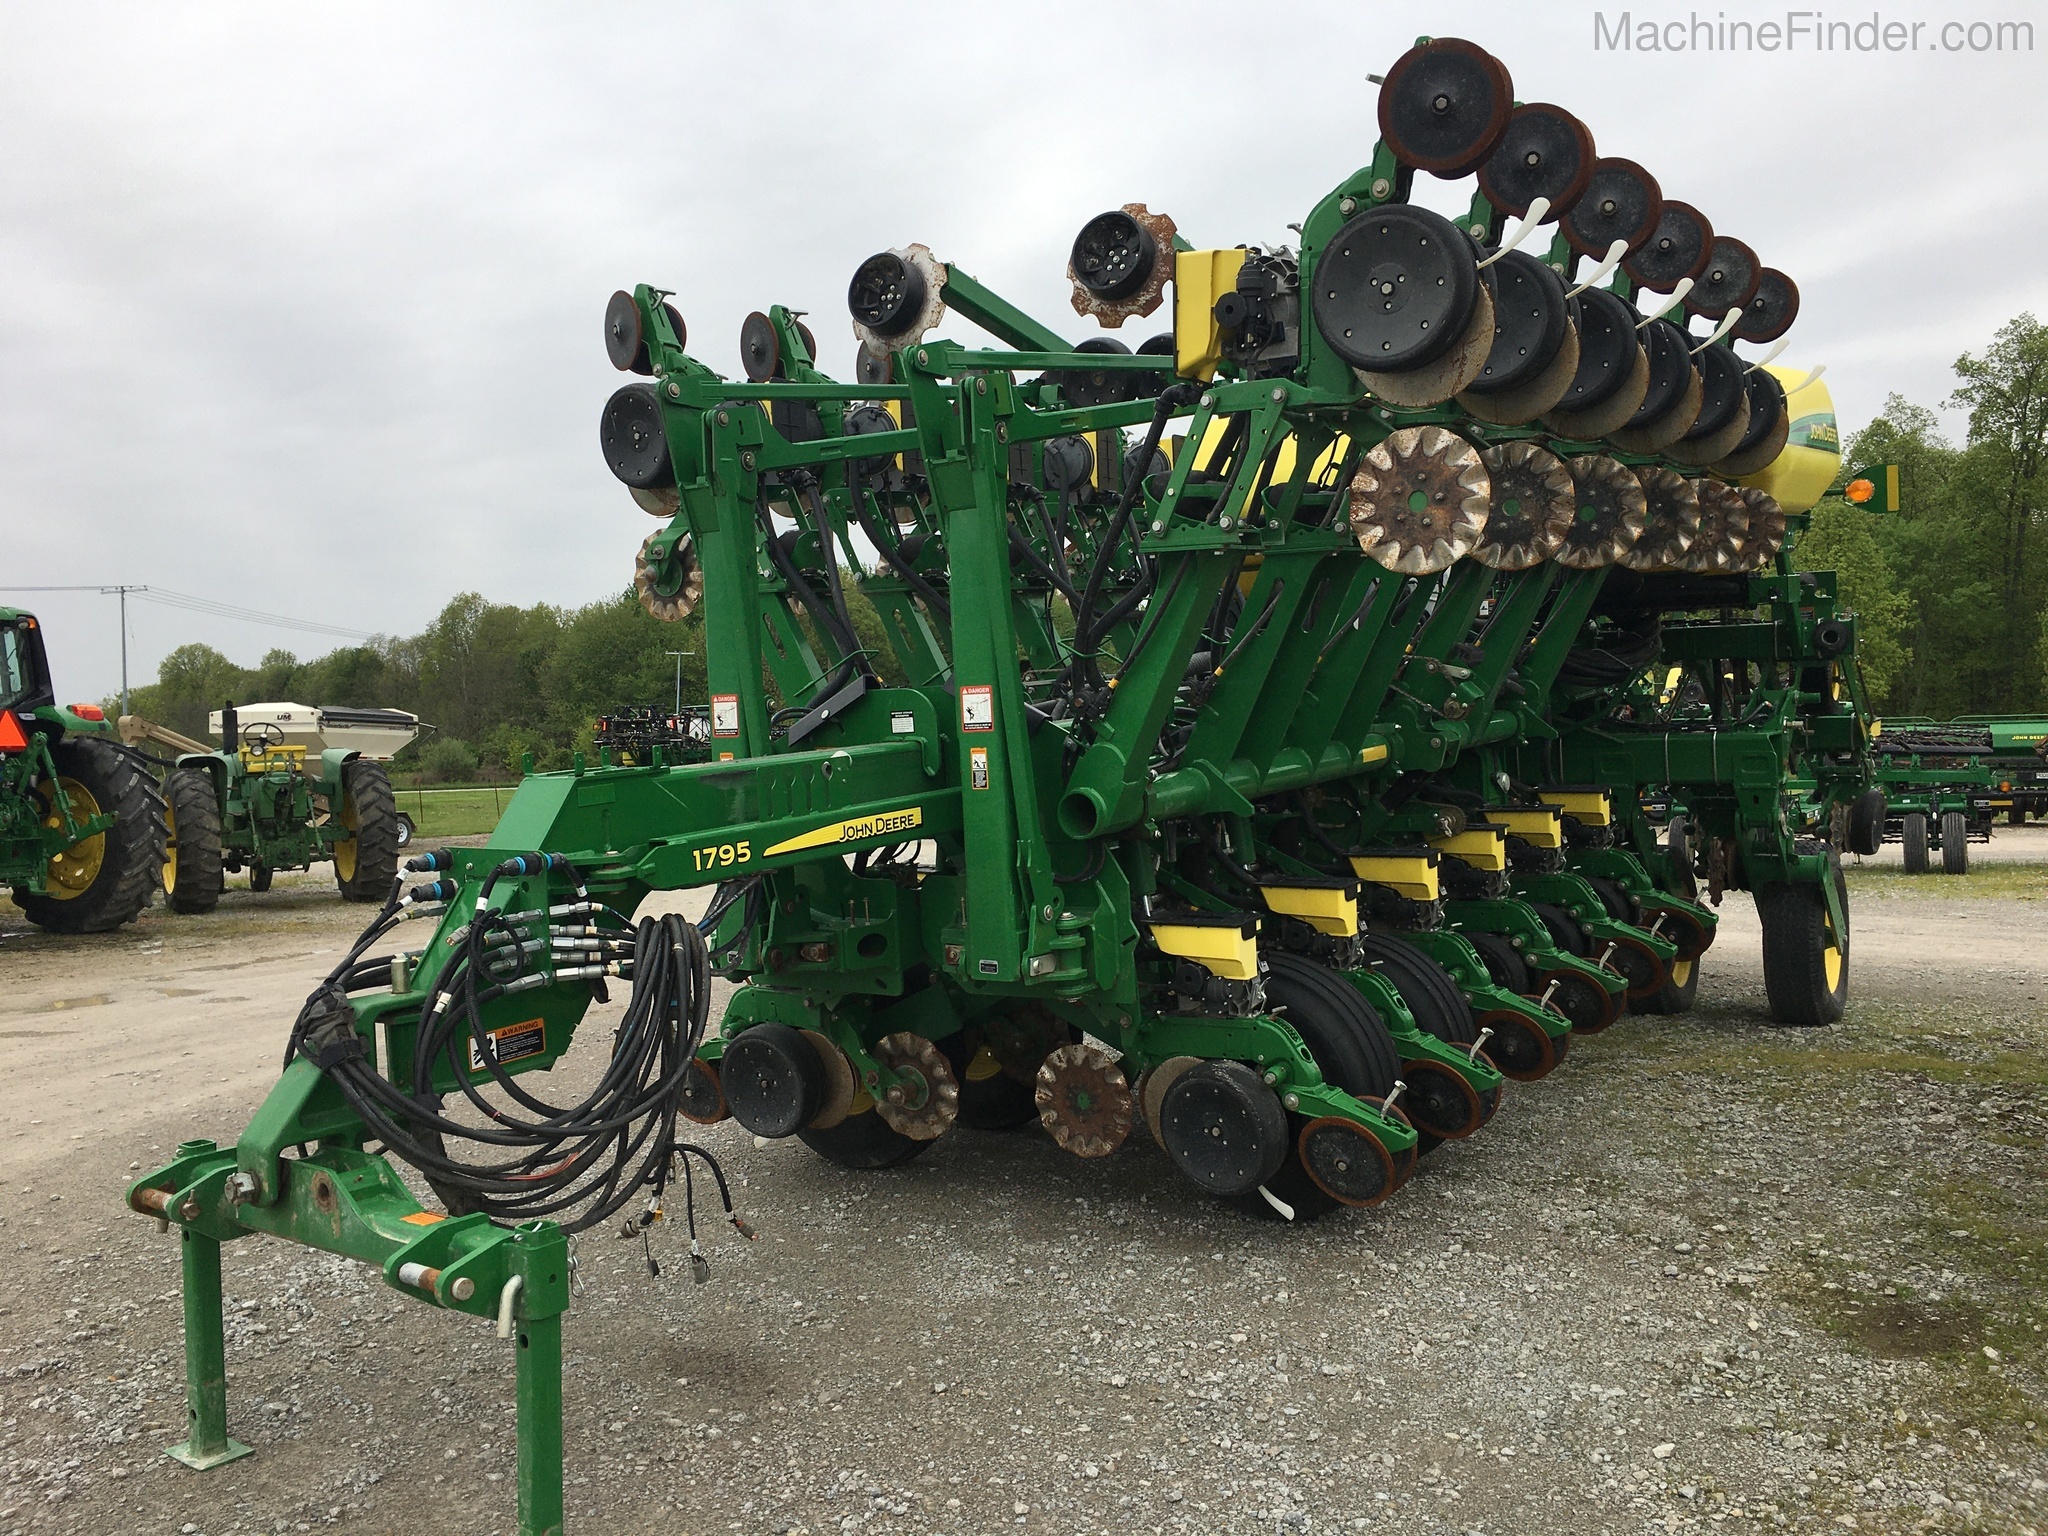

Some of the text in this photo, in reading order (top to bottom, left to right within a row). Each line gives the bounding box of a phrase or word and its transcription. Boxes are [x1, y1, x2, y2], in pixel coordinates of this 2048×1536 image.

[692, 813, 915, 872] 1795 JOHN DEERE
[507, 1021, 539, 1035] WARNING
